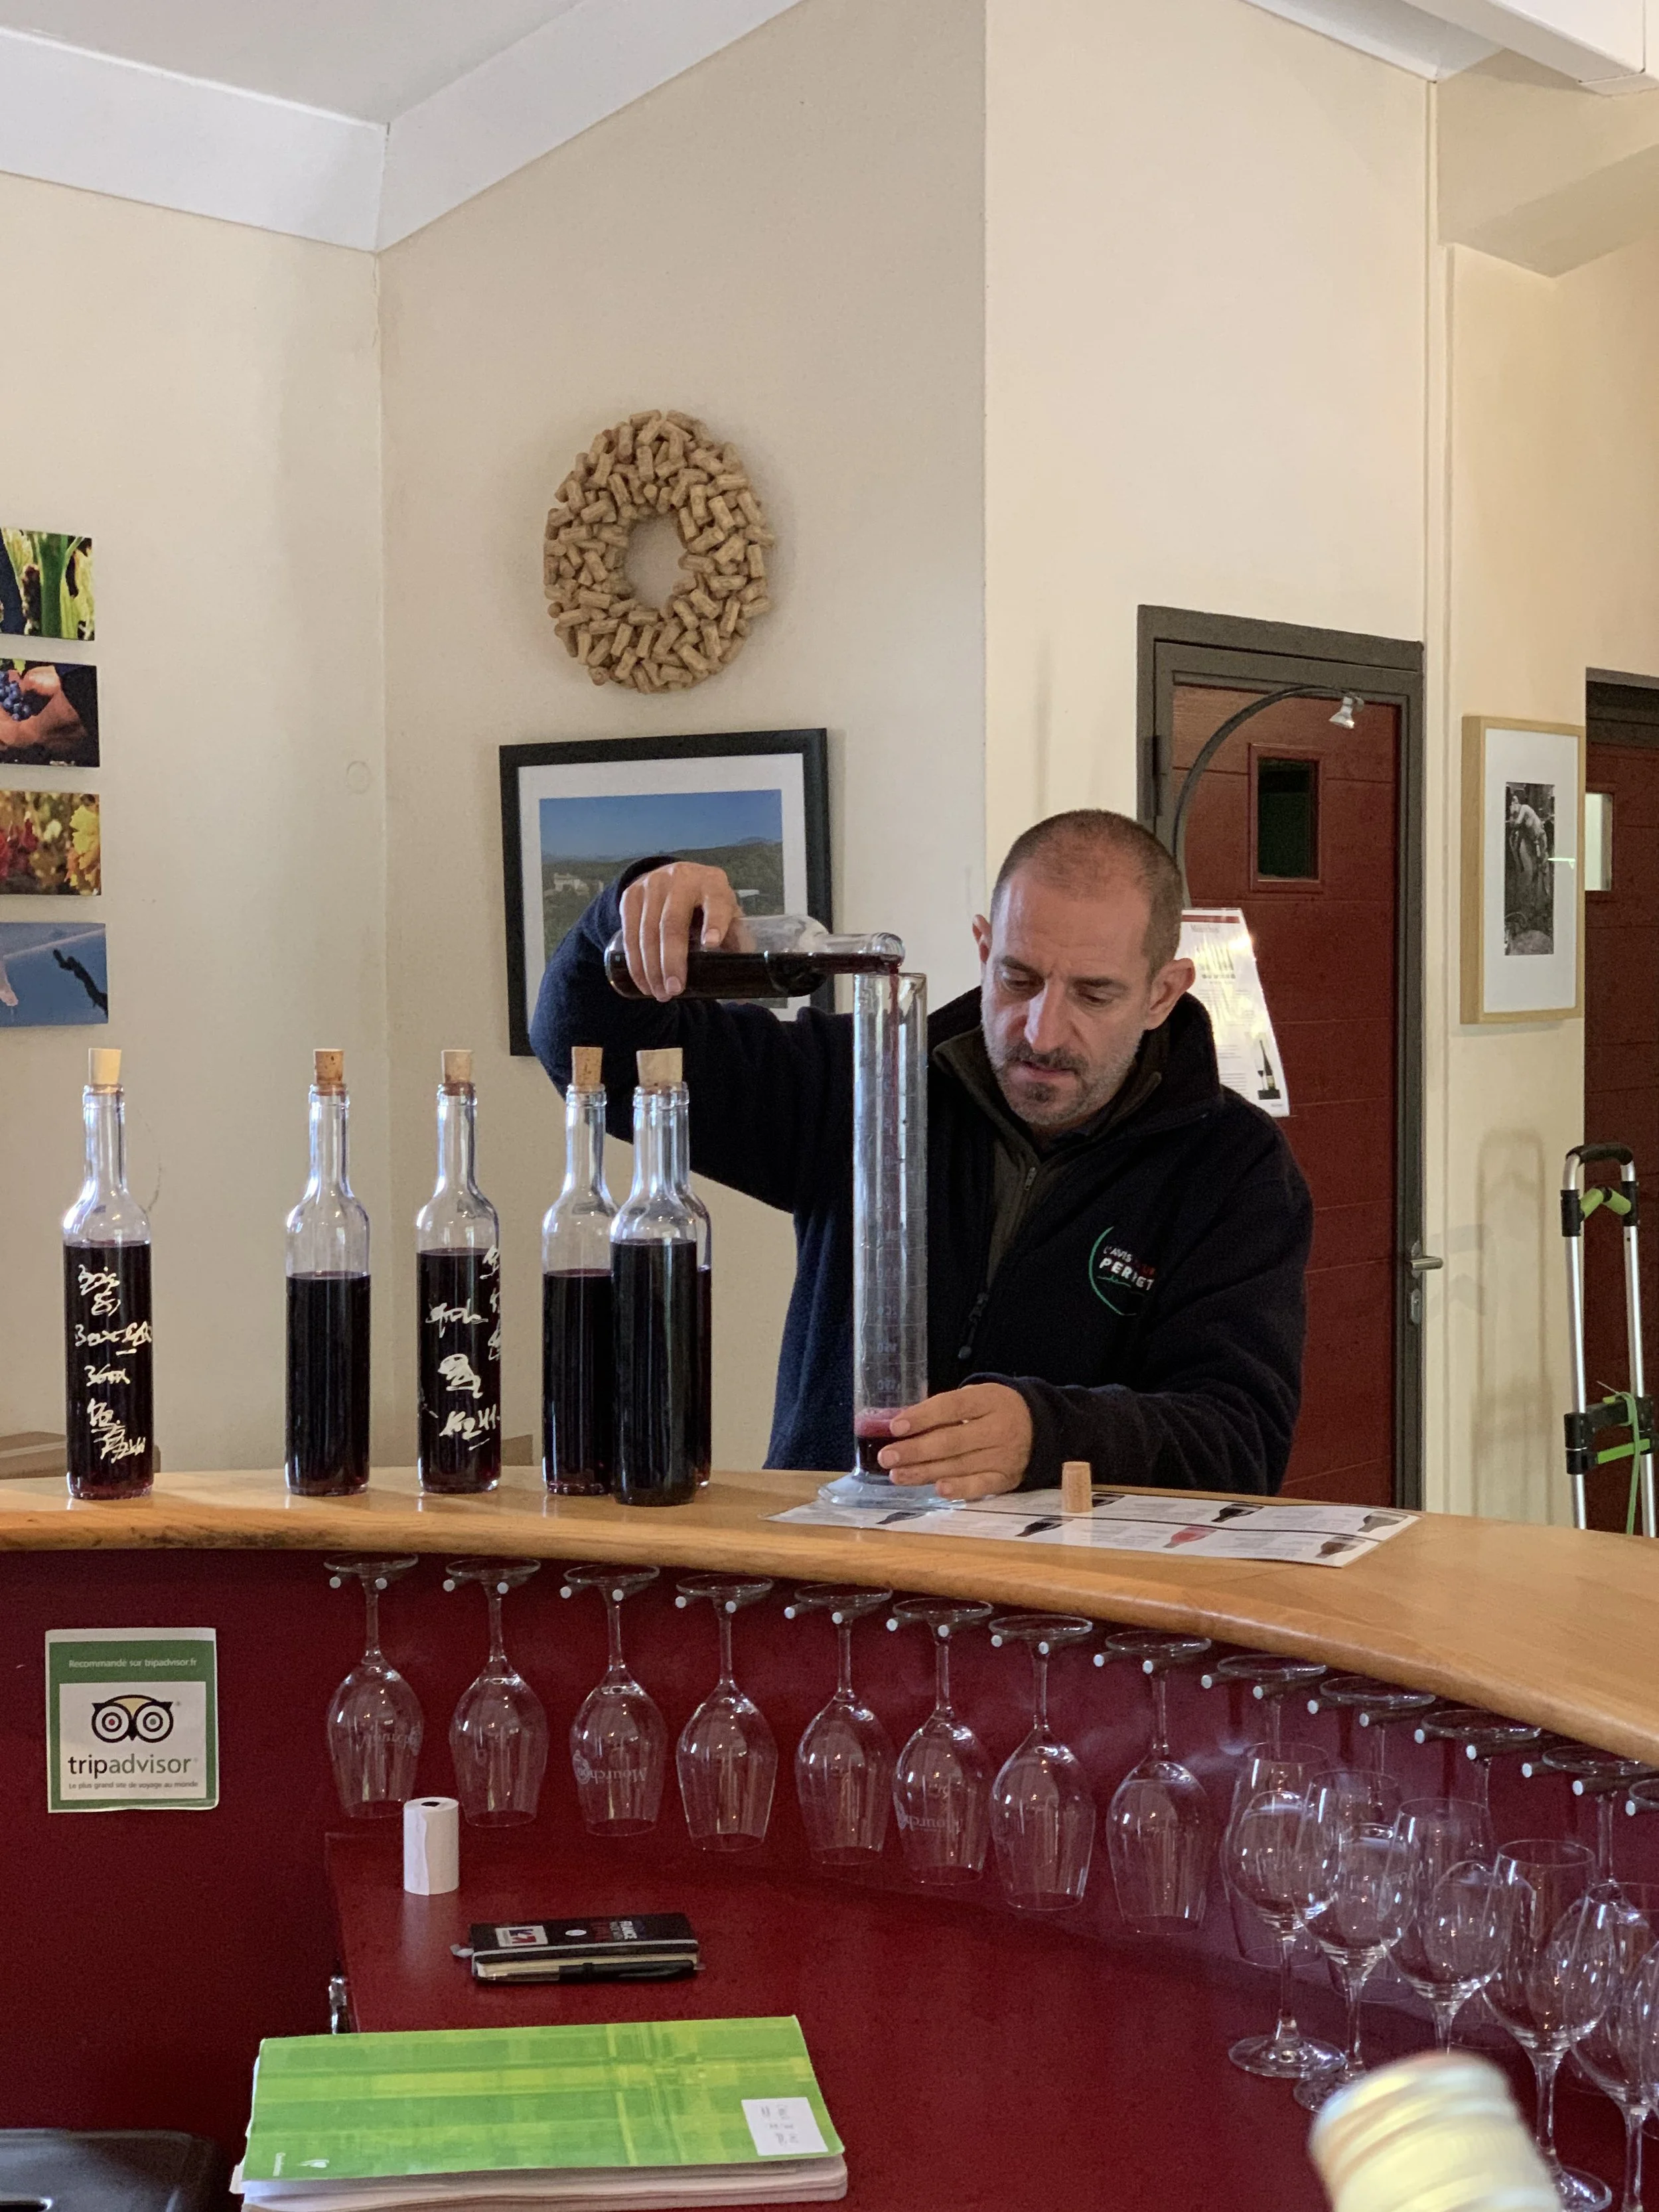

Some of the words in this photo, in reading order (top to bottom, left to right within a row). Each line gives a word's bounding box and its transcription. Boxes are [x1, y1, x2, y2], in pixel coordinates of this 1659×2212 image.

[68, 1659, 127, 1668] Recommandé
[145, 1658, 198, 1668] tripadvisor.fr
[68, 1753, 192, 1779] tripadvisor
